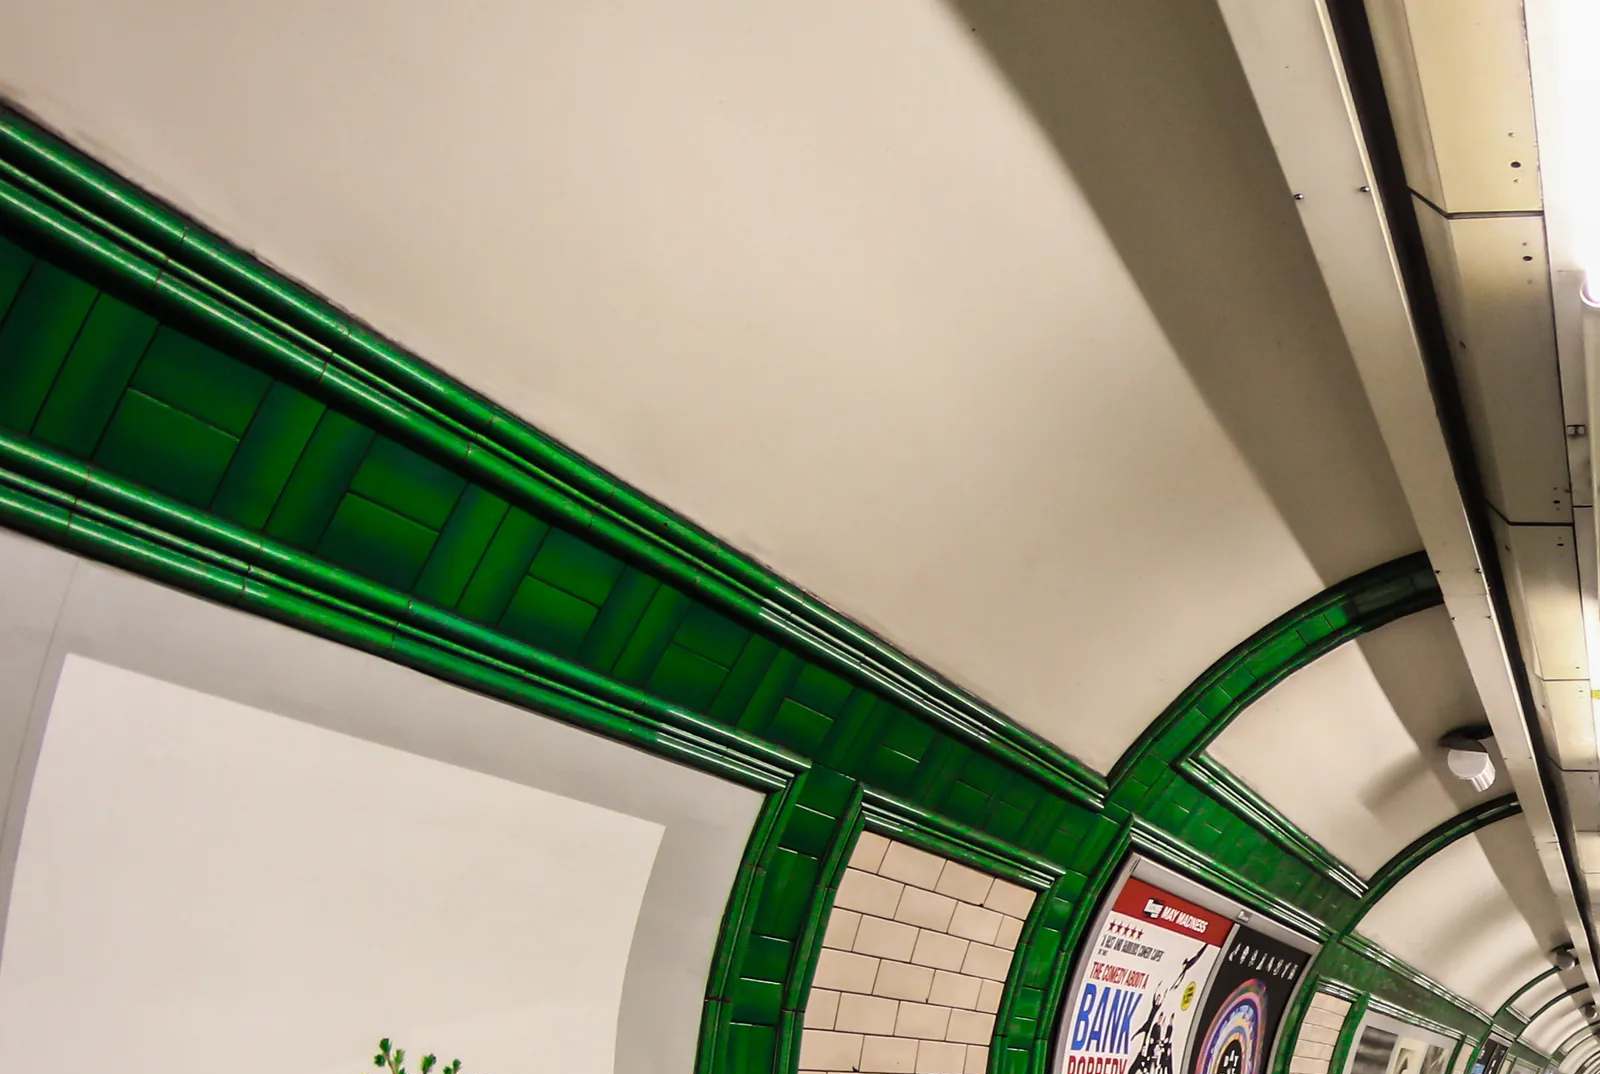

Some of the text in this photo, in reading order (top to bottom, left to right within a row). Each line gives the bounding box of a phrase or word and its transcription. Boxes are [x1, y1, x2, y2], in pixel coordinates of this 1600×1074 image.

[1161, 906, 1180, 922] MAY
[1175, 911, 1209, 933] MADNESS
[1089, 962, 1105, 980] THE
[1101, 965, 1127, 986] COMEDY
[1123, 969, 1146, 989] ABOUT
[1071, 983, 1143, 1054] BANK
